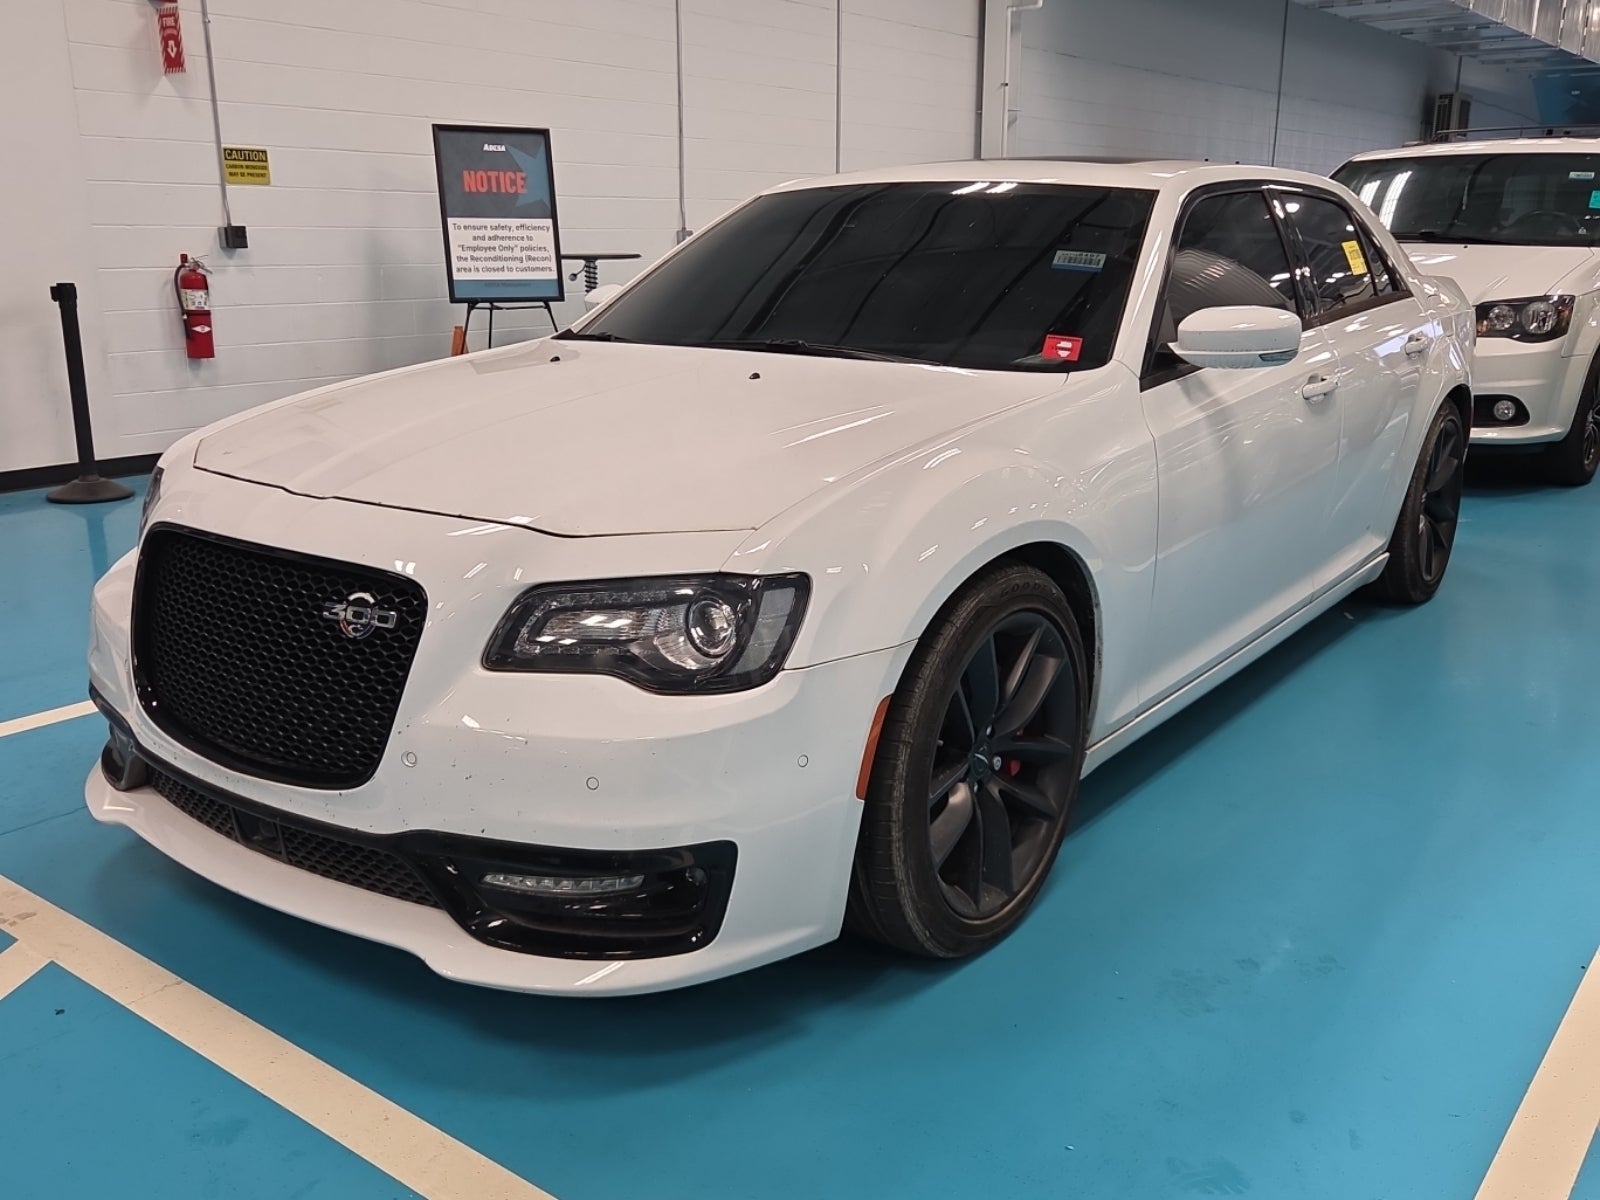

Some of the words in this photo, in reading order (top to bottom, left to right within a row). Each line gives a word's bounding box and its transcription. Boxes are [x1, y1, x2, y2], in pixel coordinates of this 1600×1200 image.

[225, 149, 266, 161] CAUTION
[463, 170, 528, 194] NOTICE
[452, 223, 461, 231] To
[515, 223, 550, 232] efficiency
[456, 254, 469, 262] the
[470, 254, 524, 263] Reconditioning
[525, 255, 552, 263] (Recon)
